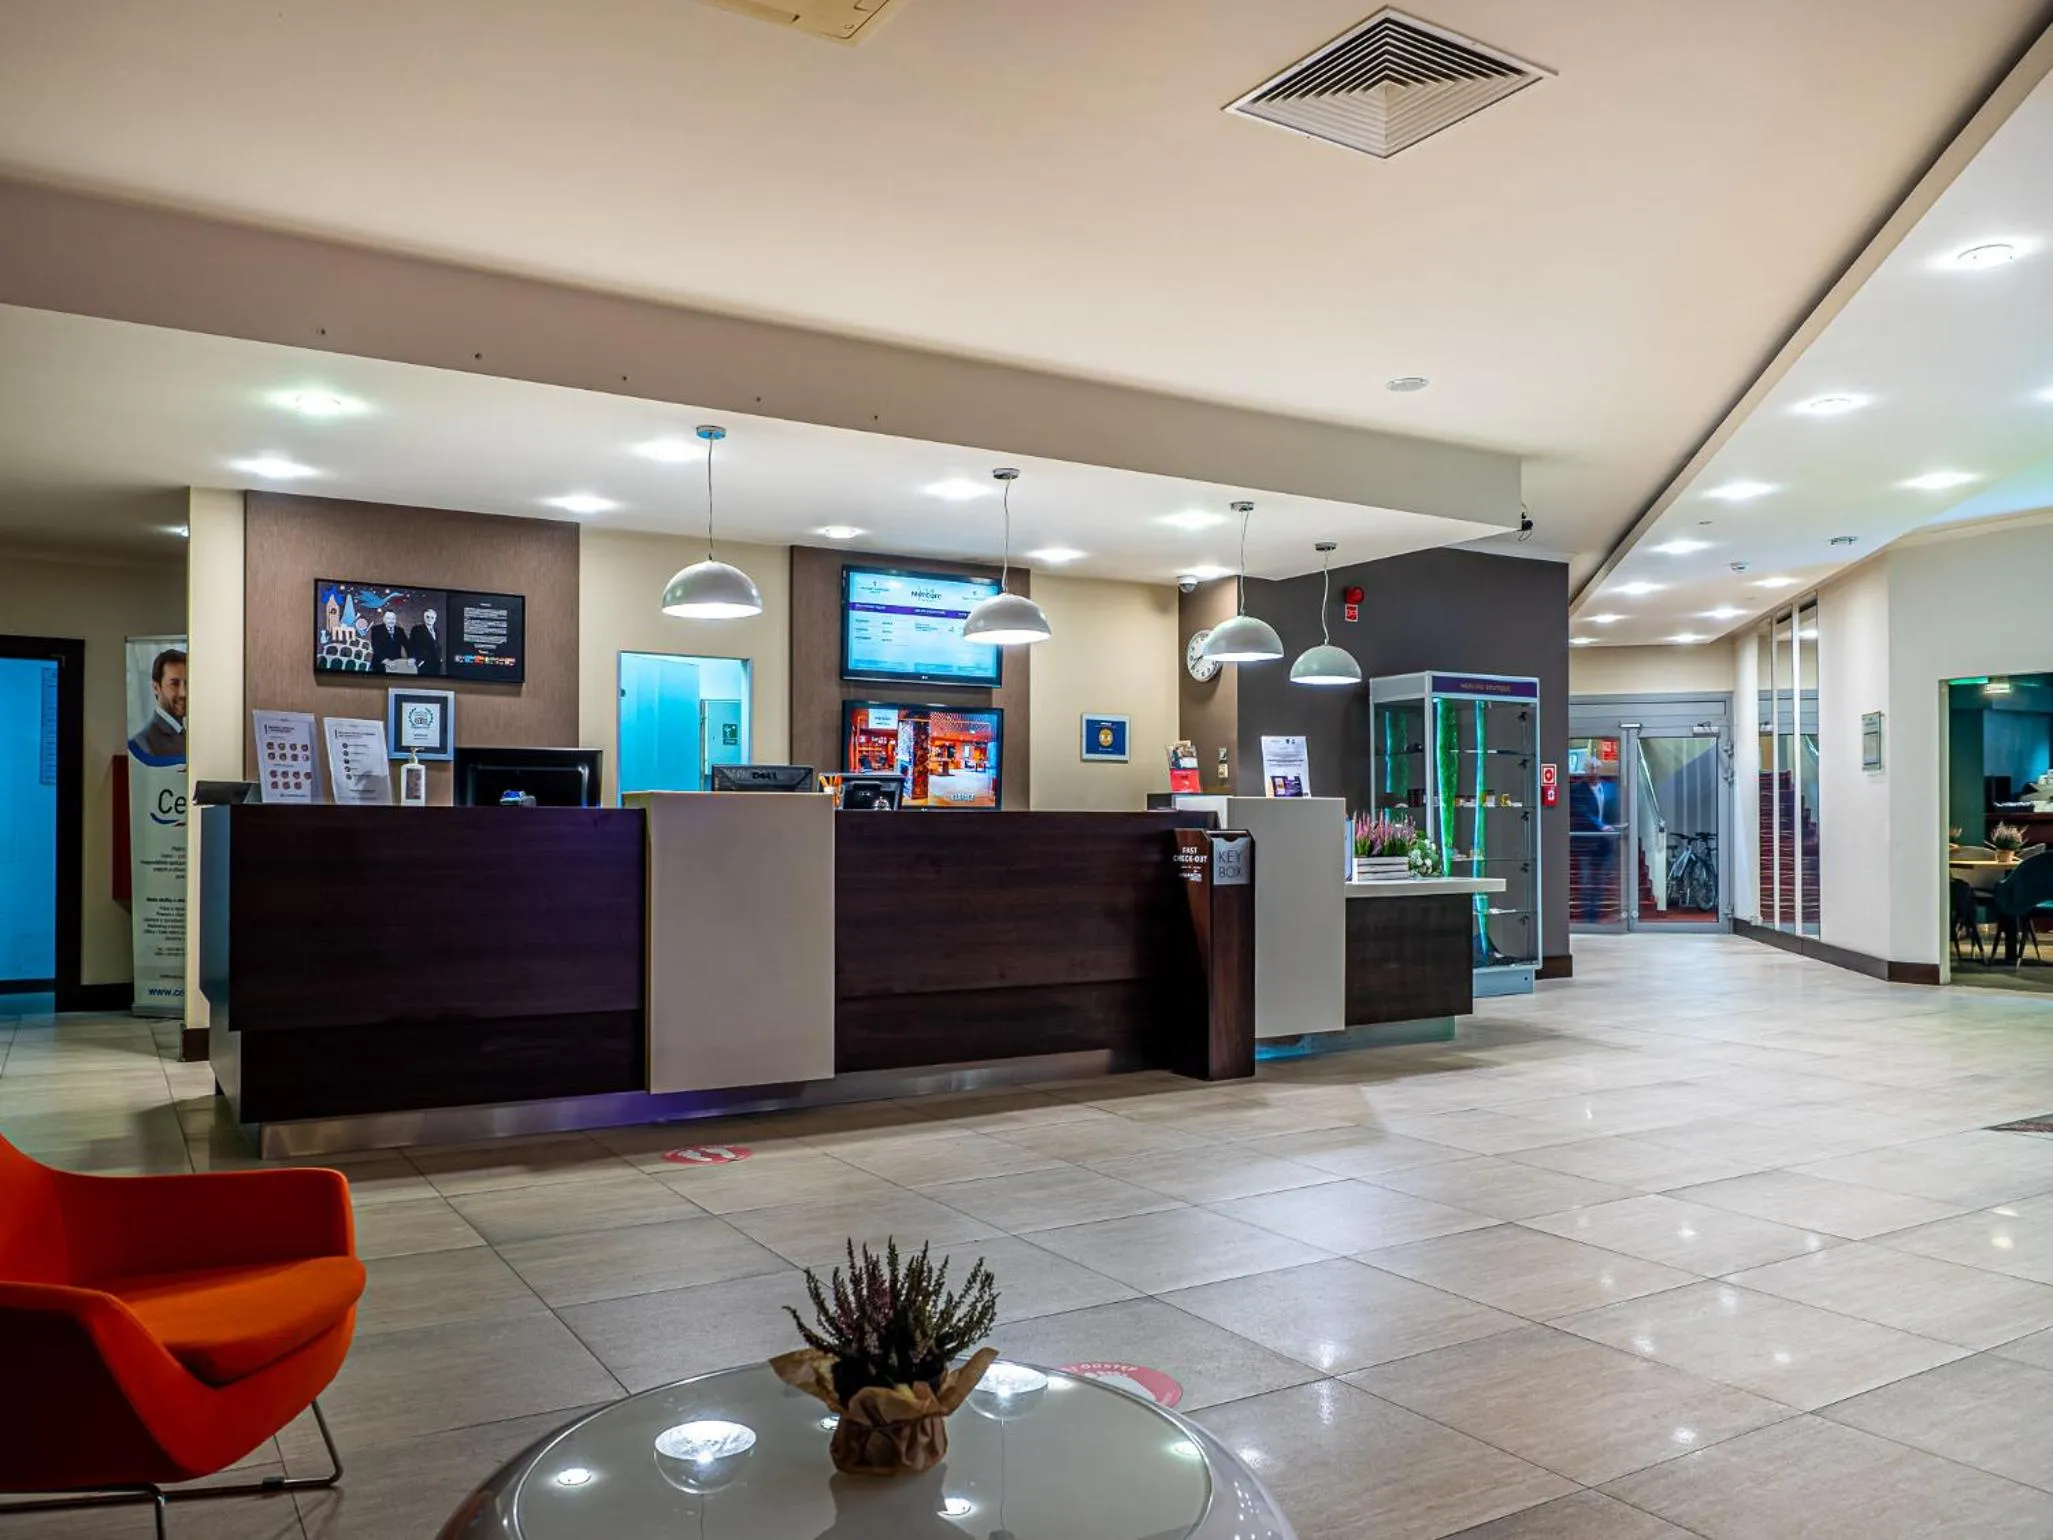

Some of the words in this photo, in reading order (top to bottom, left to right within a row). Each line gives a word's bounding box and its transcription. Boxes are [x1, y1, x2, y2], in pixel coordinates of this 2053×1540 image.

[752, 771, 777, 780] DELL
[1173, 855, 1208, 863] CHECK-OUT
[1219, 849, 1244, 863] KEY
[1219, 866, 1242, 878] BOX
